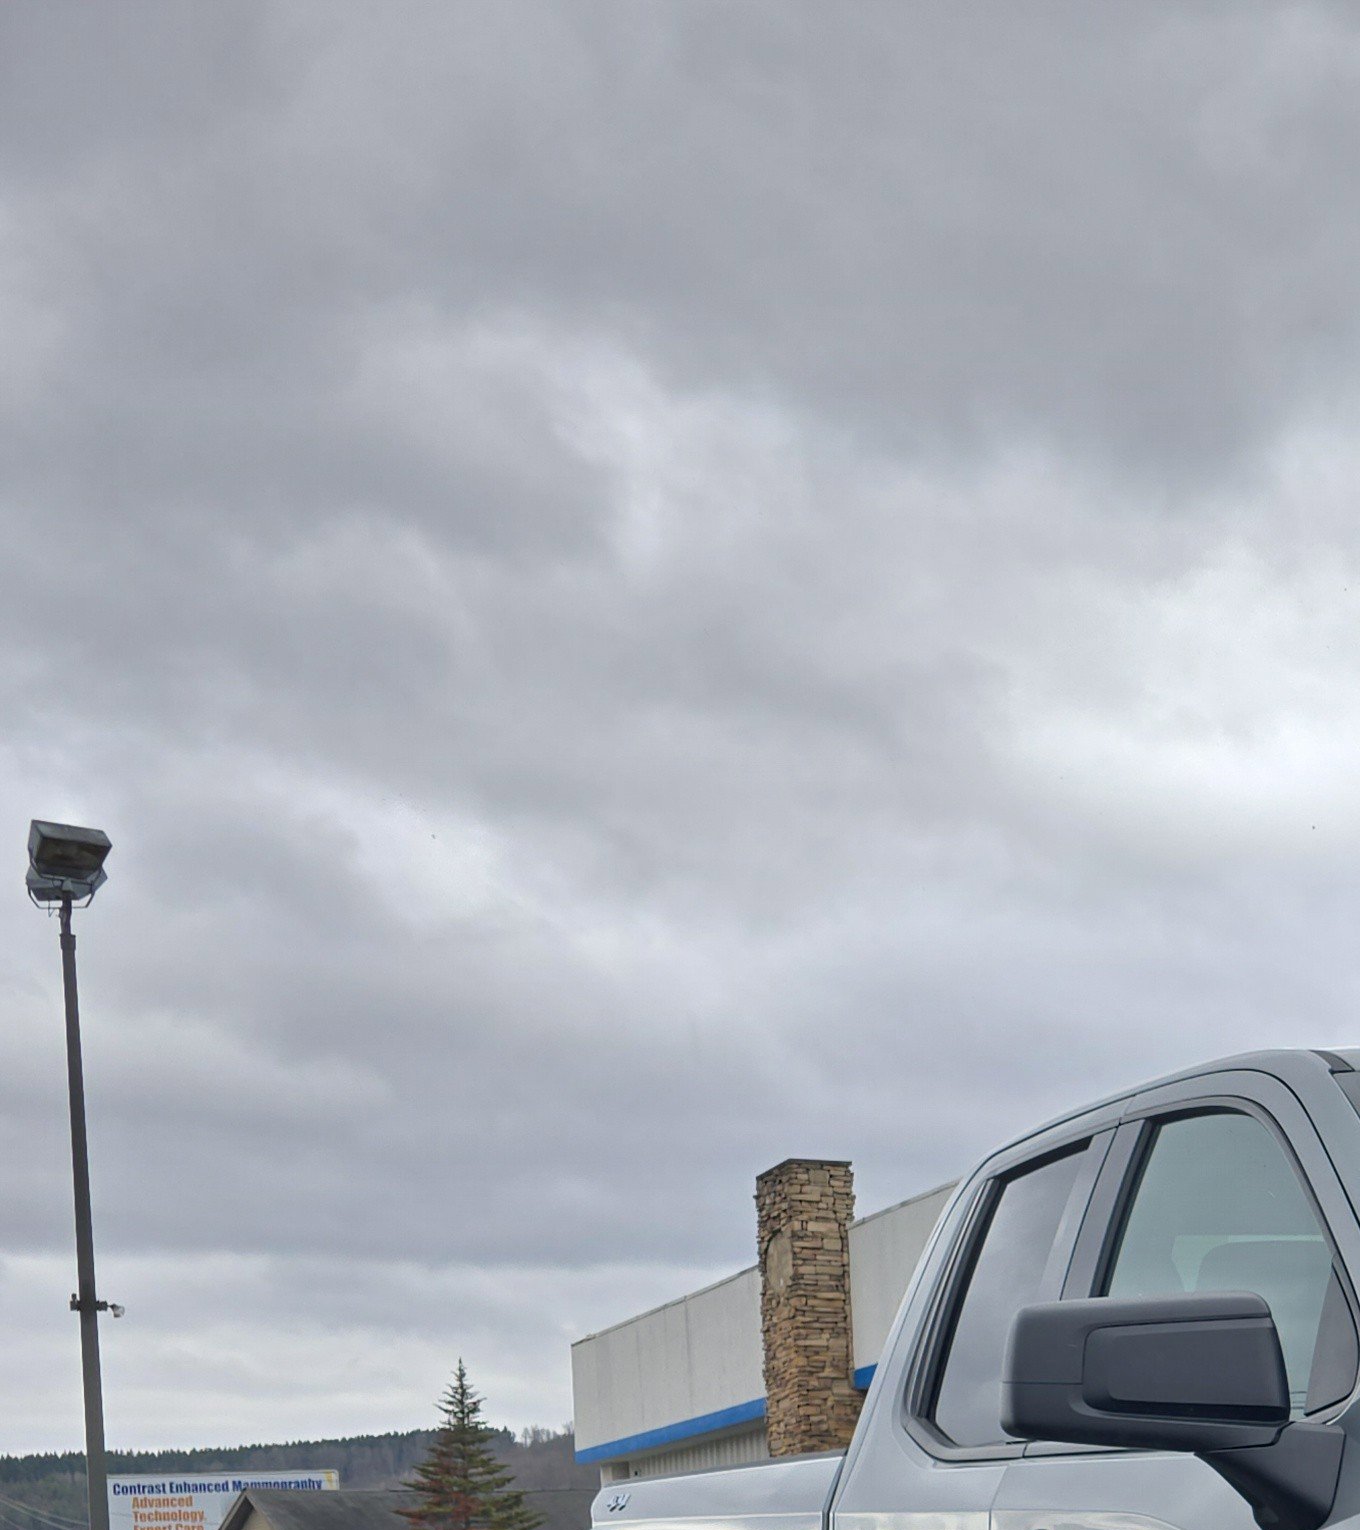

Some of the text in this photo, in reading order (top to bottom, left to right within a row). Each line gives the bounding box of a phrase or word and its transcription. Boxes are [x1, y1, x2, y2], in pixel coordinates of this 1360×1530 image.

[113, 1481, 166, 1496] Contrast
[169, 1480, 229, 1494] Enhanced
[132, 1495, 193, 1508] Advanced
